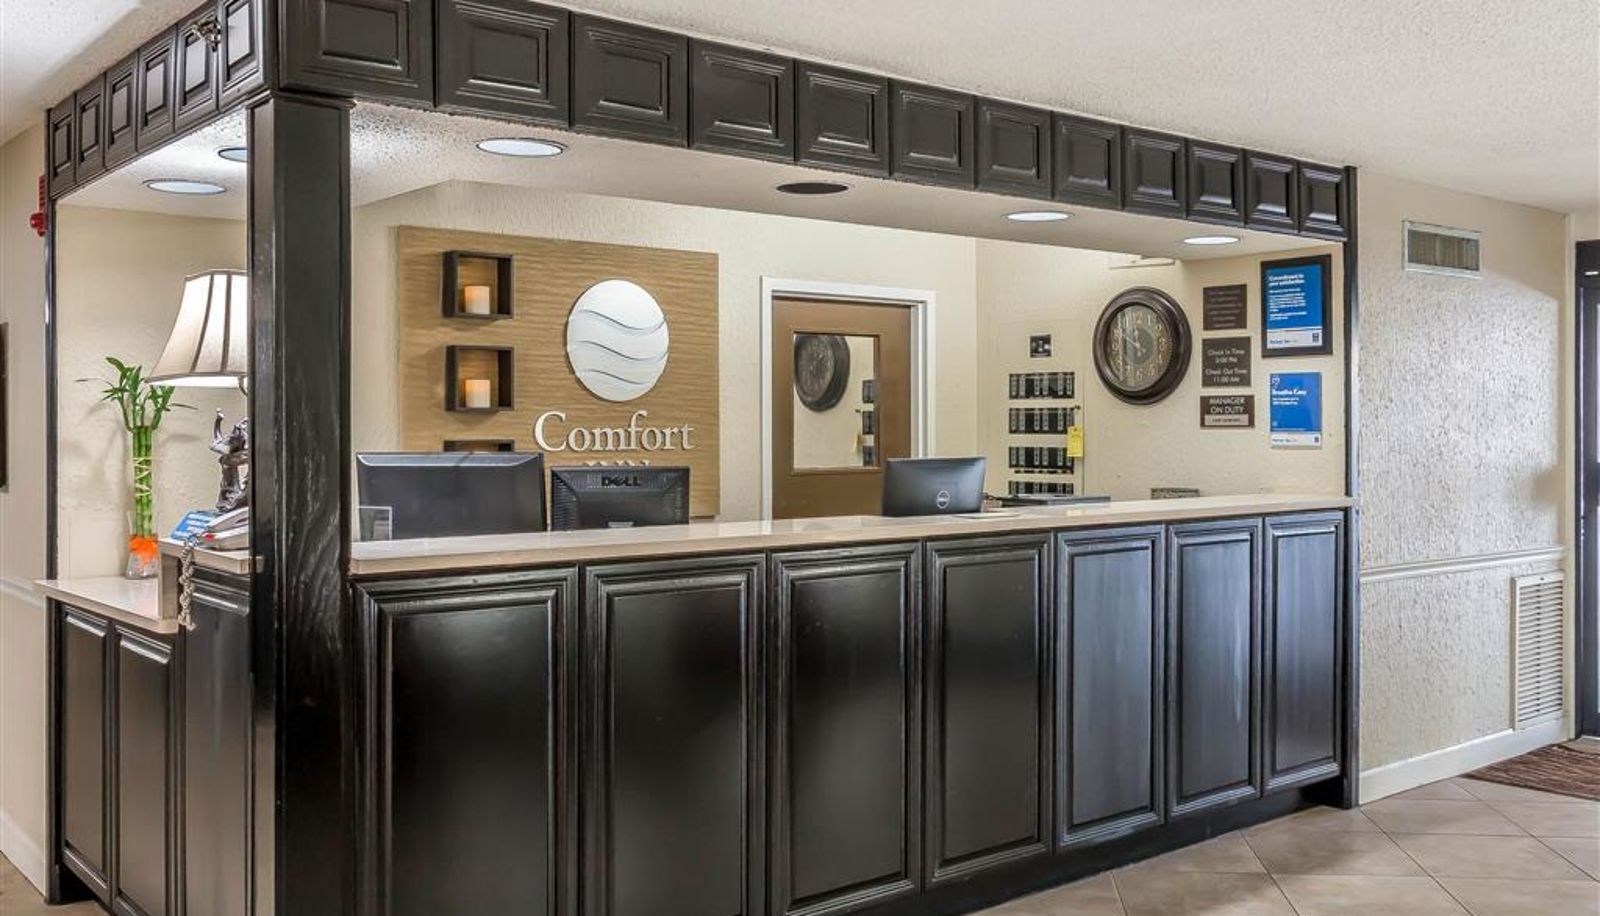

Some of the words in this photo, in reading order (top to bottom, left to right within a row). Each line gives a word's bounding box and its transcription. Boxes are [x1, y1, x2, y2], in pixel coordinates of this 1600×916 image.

[1209, 397, 1246, 405] MANAGER
[1210, 406, 1223, 414] ON
[1224, 406, 1244, 414] DUTY
[534, 409, 696, 451] Comfort
[601, 476, 641, 487] DELL
